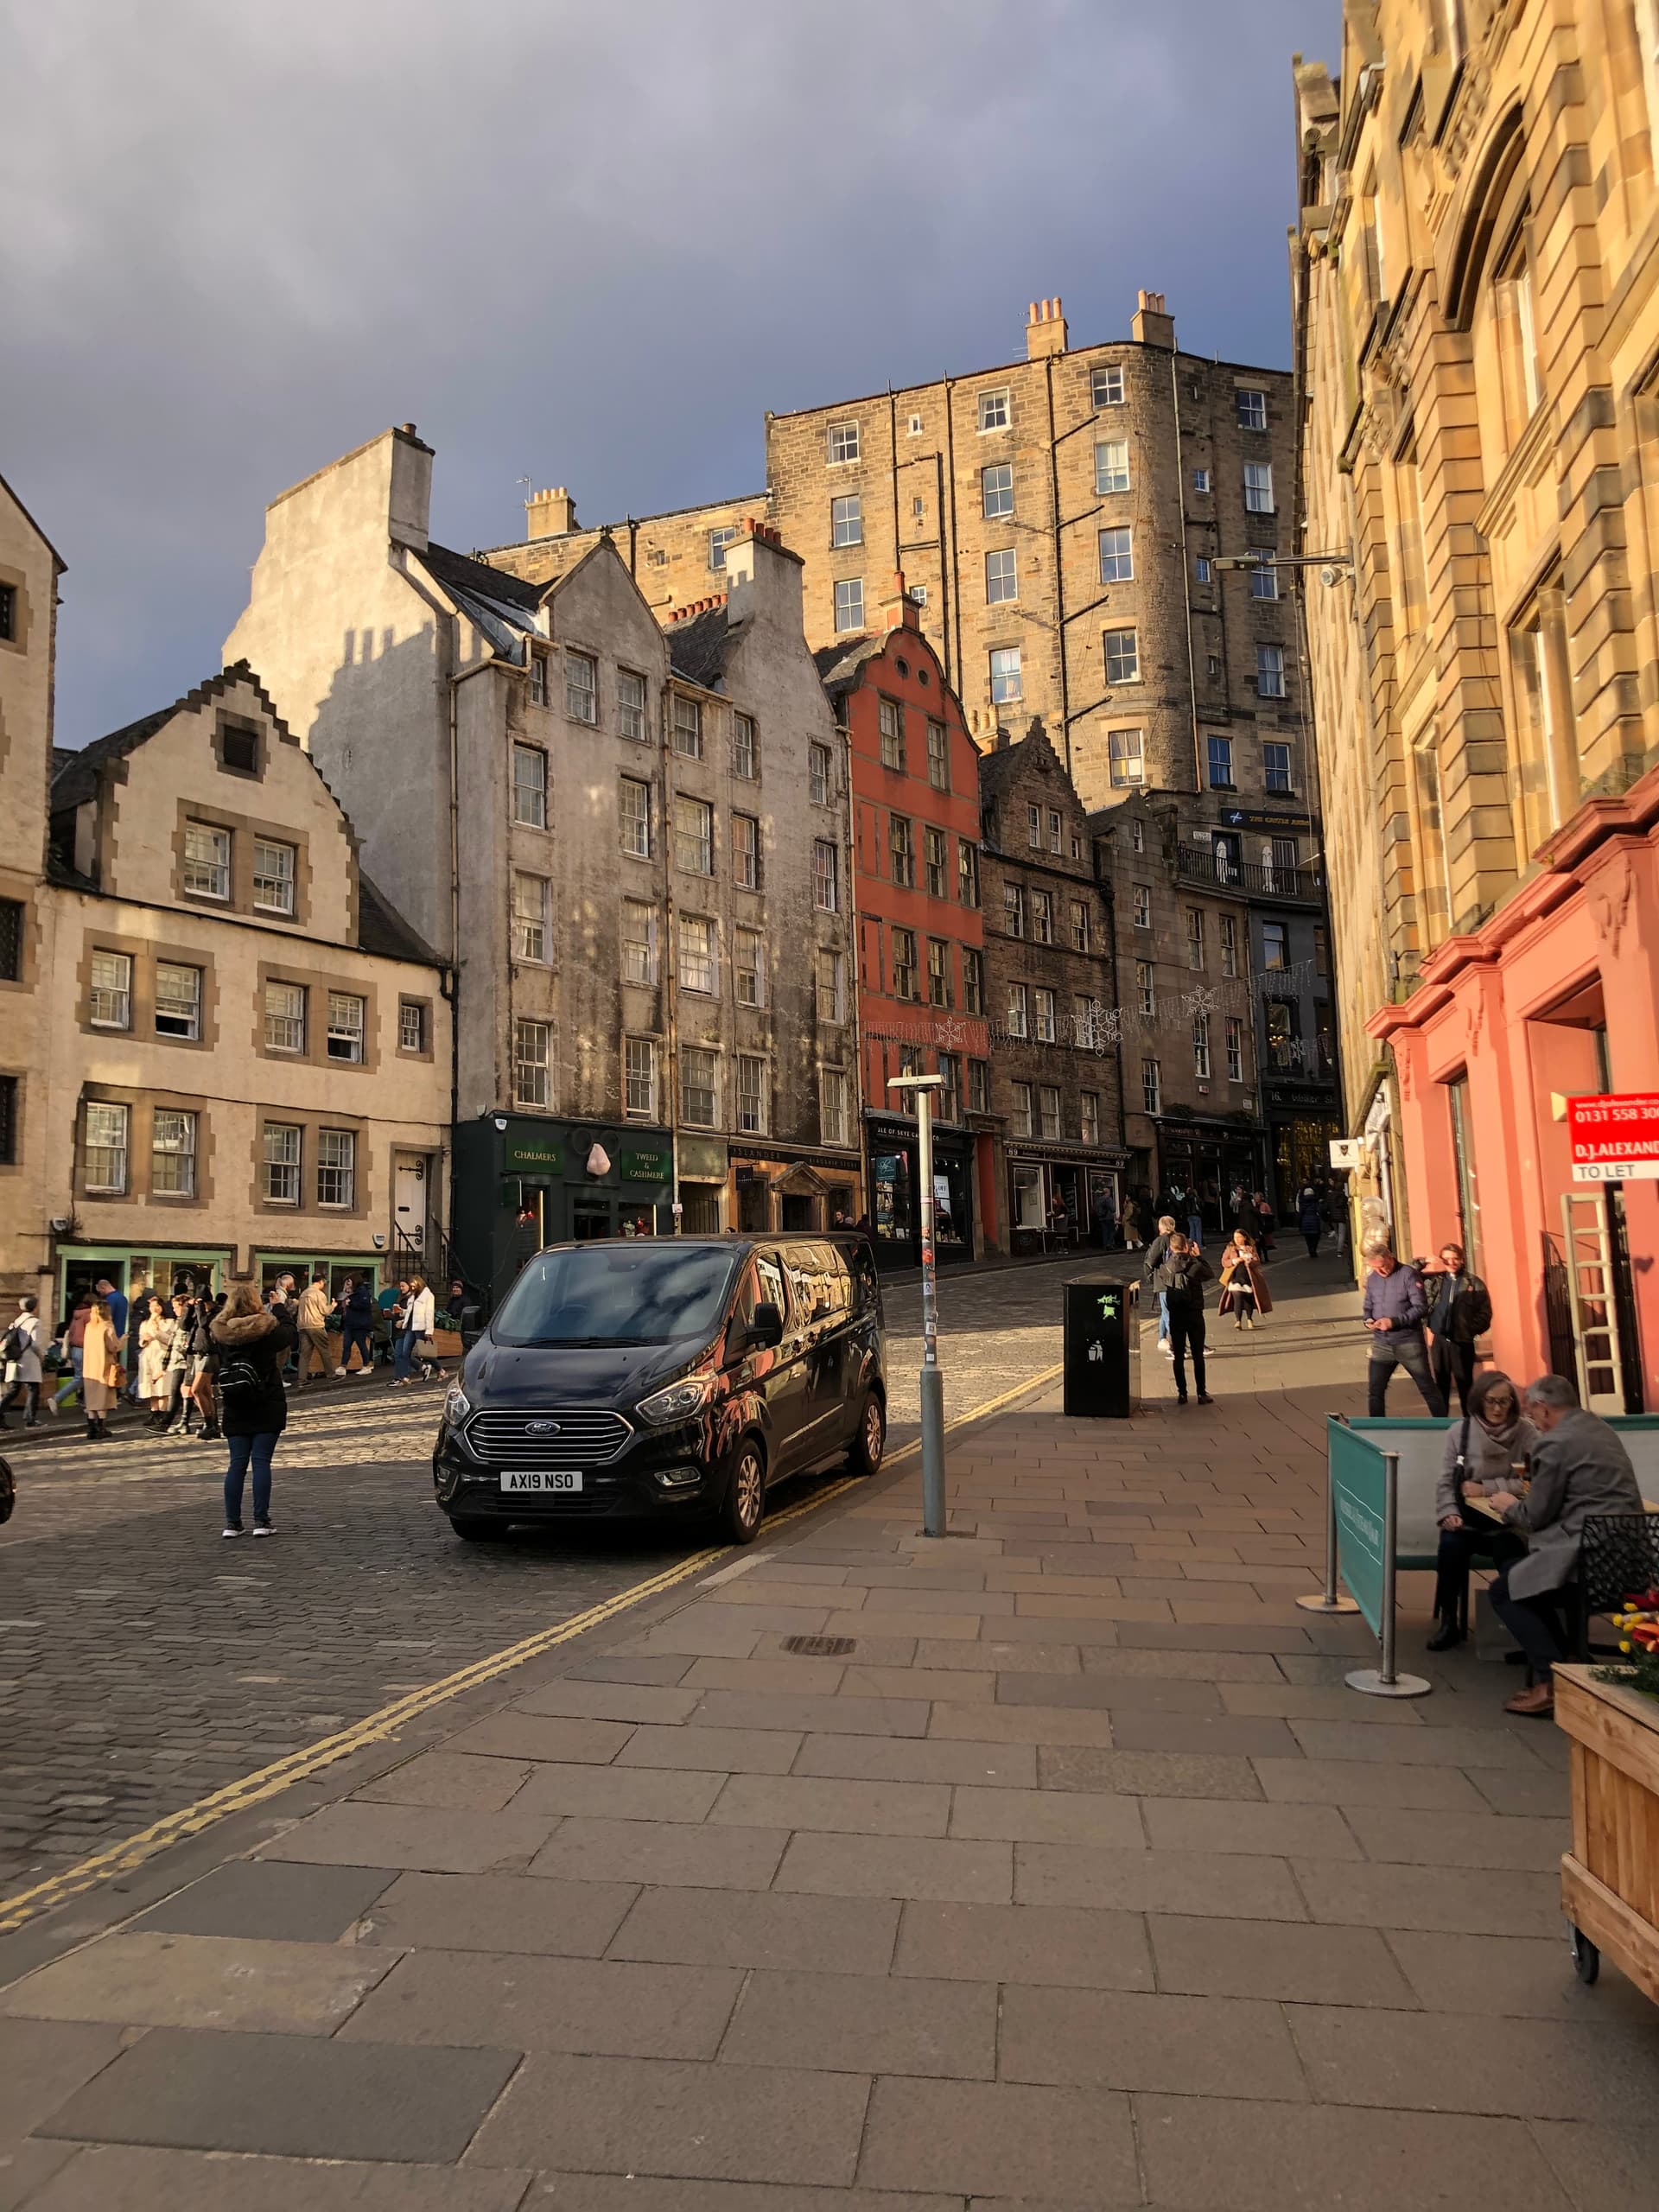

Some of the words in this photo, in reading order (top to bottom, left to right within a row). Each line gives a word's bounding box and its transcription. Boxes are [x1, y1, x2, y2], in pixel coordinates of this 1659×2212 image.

[1575, 1110, 1608, 1122] 0131
[1612, 1109, 1638, 1121] 558
[514, 1150, 556, 1162] CHALMERS
[636, 1153, 658, 1161] TWEED
[629, 1169, 664, 1180] CASHMERE
[1578, 1166, 1600, 1179] TO
[1605, 1164, 1635, 1178] LET
[510, 1474, 541, 1489] AX19
[545, 1474, 574, 1489] NSO
